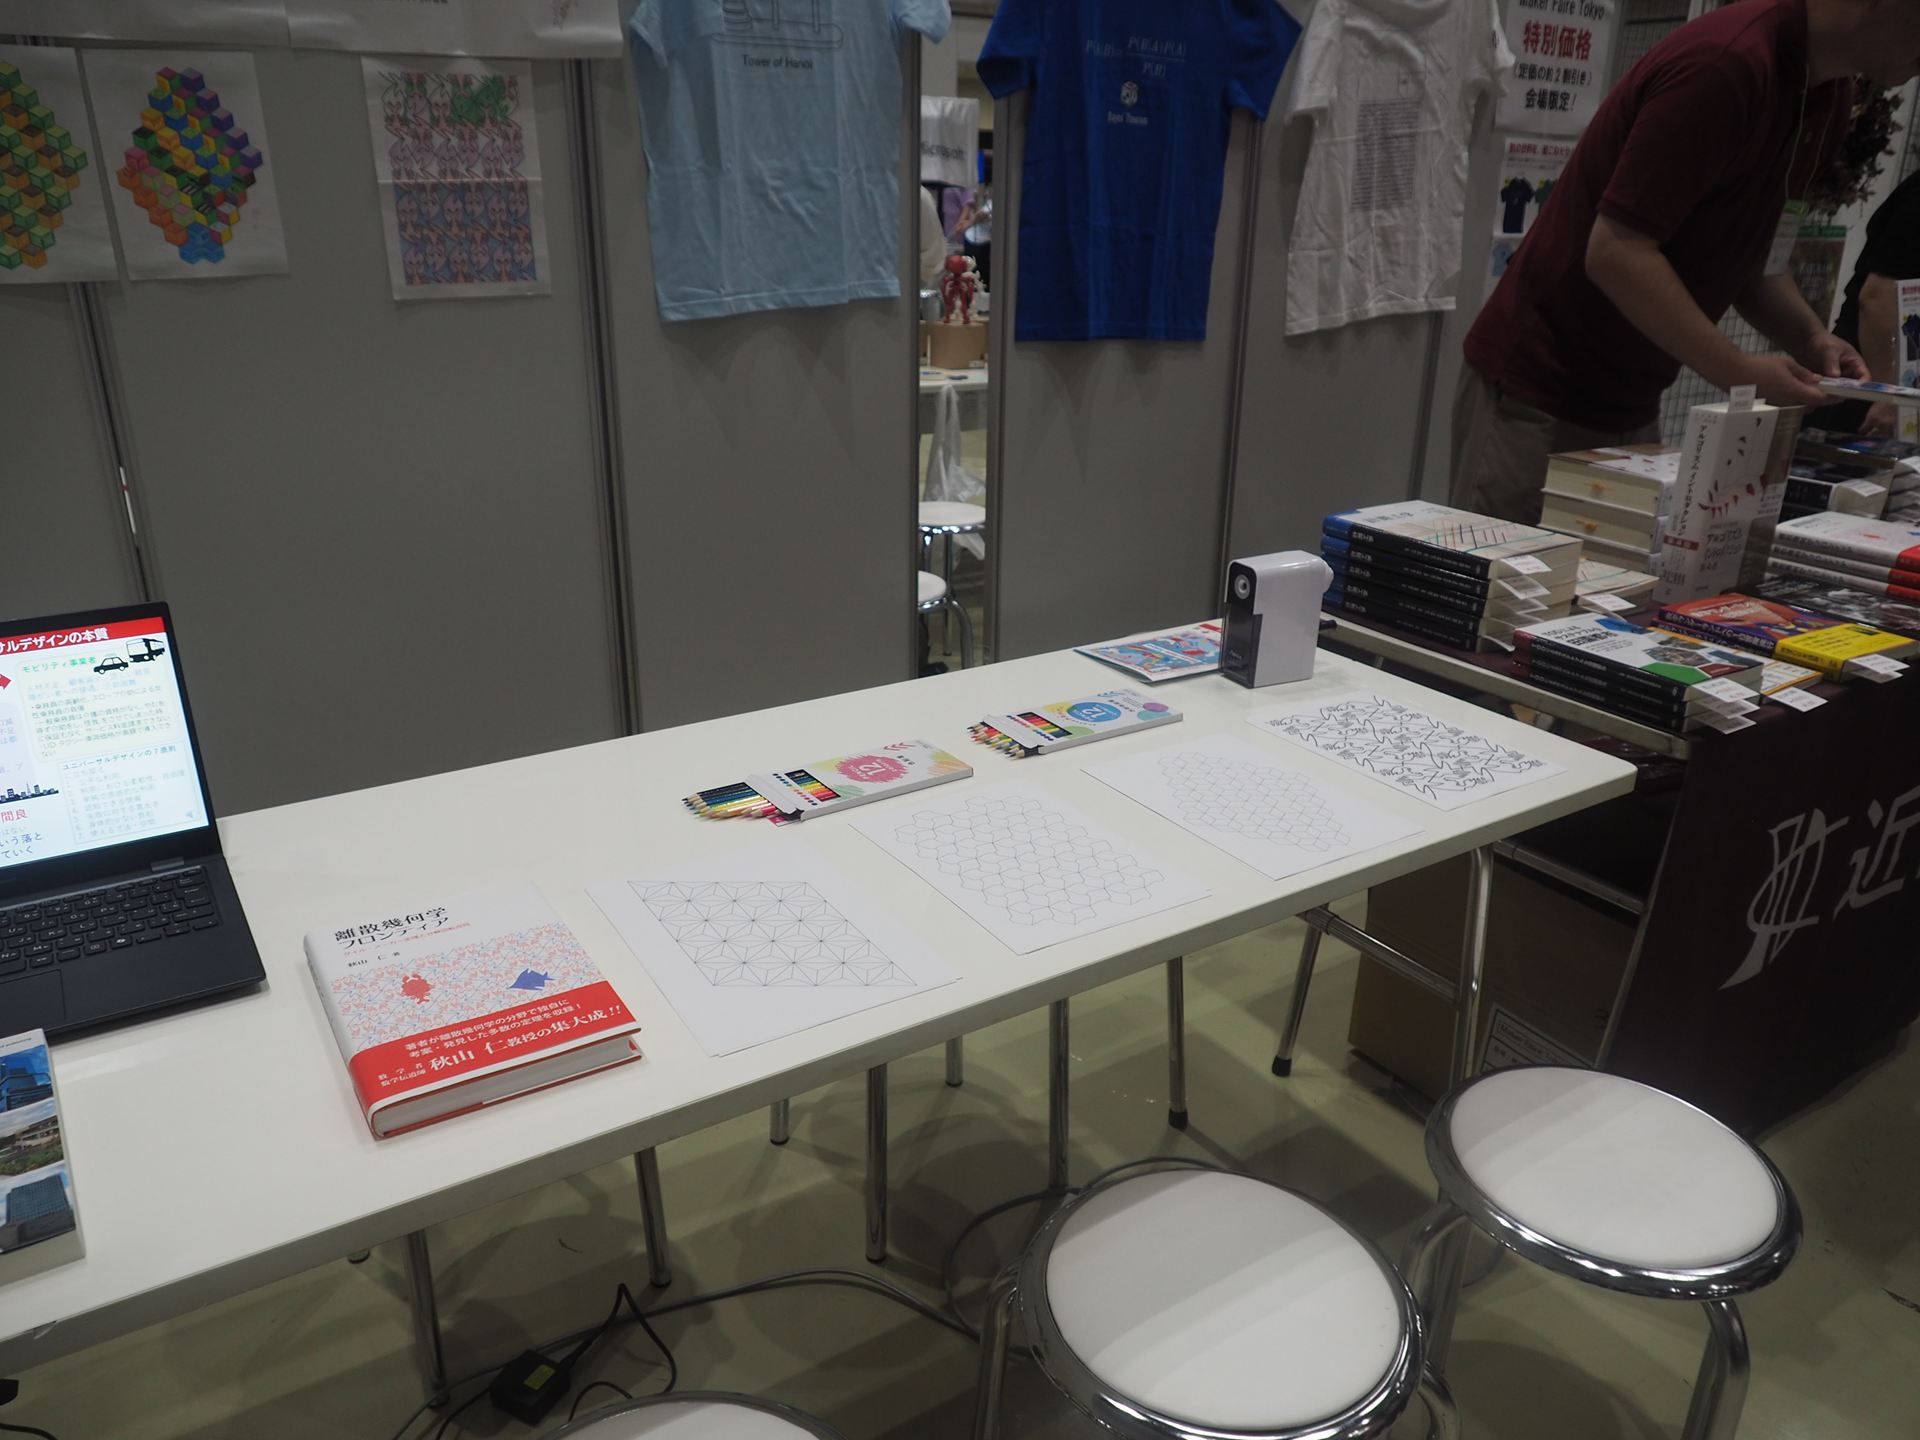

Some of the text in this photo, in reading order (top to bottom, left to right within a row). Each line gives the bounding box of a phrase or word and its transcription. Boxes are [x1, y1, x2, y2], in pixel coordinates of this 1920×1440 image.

[1522, 19, 1593, 61] 特別価格
[741, 54, 814, 70] Tower of Hanoi
[23, 656, 97, 673] モビリティ事業者
[1082, 705, 1108, 719] 12
[859, 762, 887, 777] 12
[334, 906, 448, 942] 離散幾何学
[336, 917, 450, 950] フロンティア
[428, 1049, 476, 1072] 秋山
